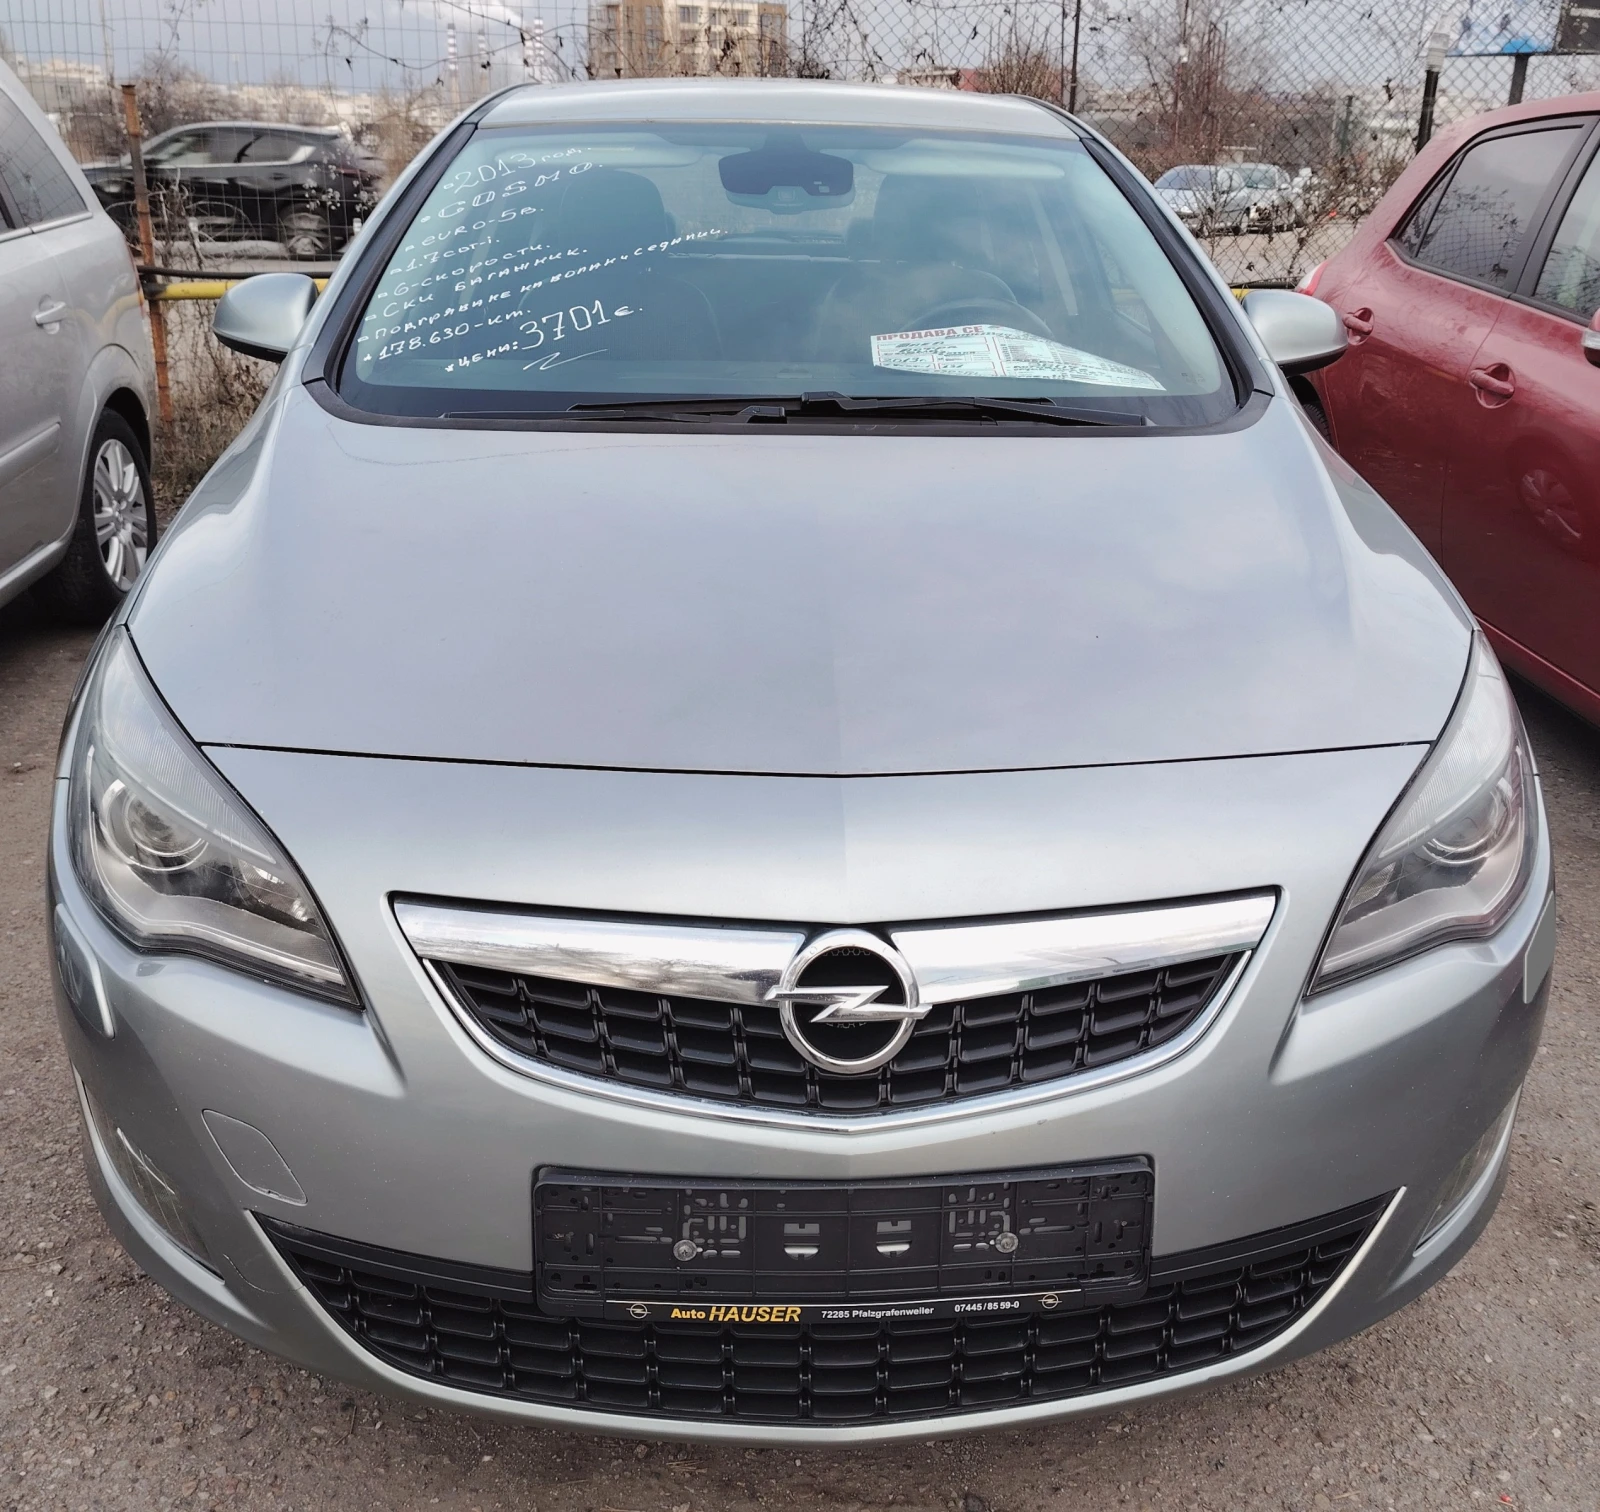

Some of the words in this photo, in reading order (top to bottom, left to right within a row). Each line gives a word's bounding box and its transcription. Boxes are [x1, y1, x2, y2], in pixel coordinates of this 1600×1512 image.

[454, 152, 536, 194] 2013
[876, 328, 958, 341] ПРОДАВА
[962, 325, 985, 334] СЕ
[670, 1308, 706, 1319] Auto
[708, 1306, 801, 1322] HAUSER
[821, 1309, 850, 1319] 72285
[852, 1306, 935, 1320] Pfalzgrafenweiler
